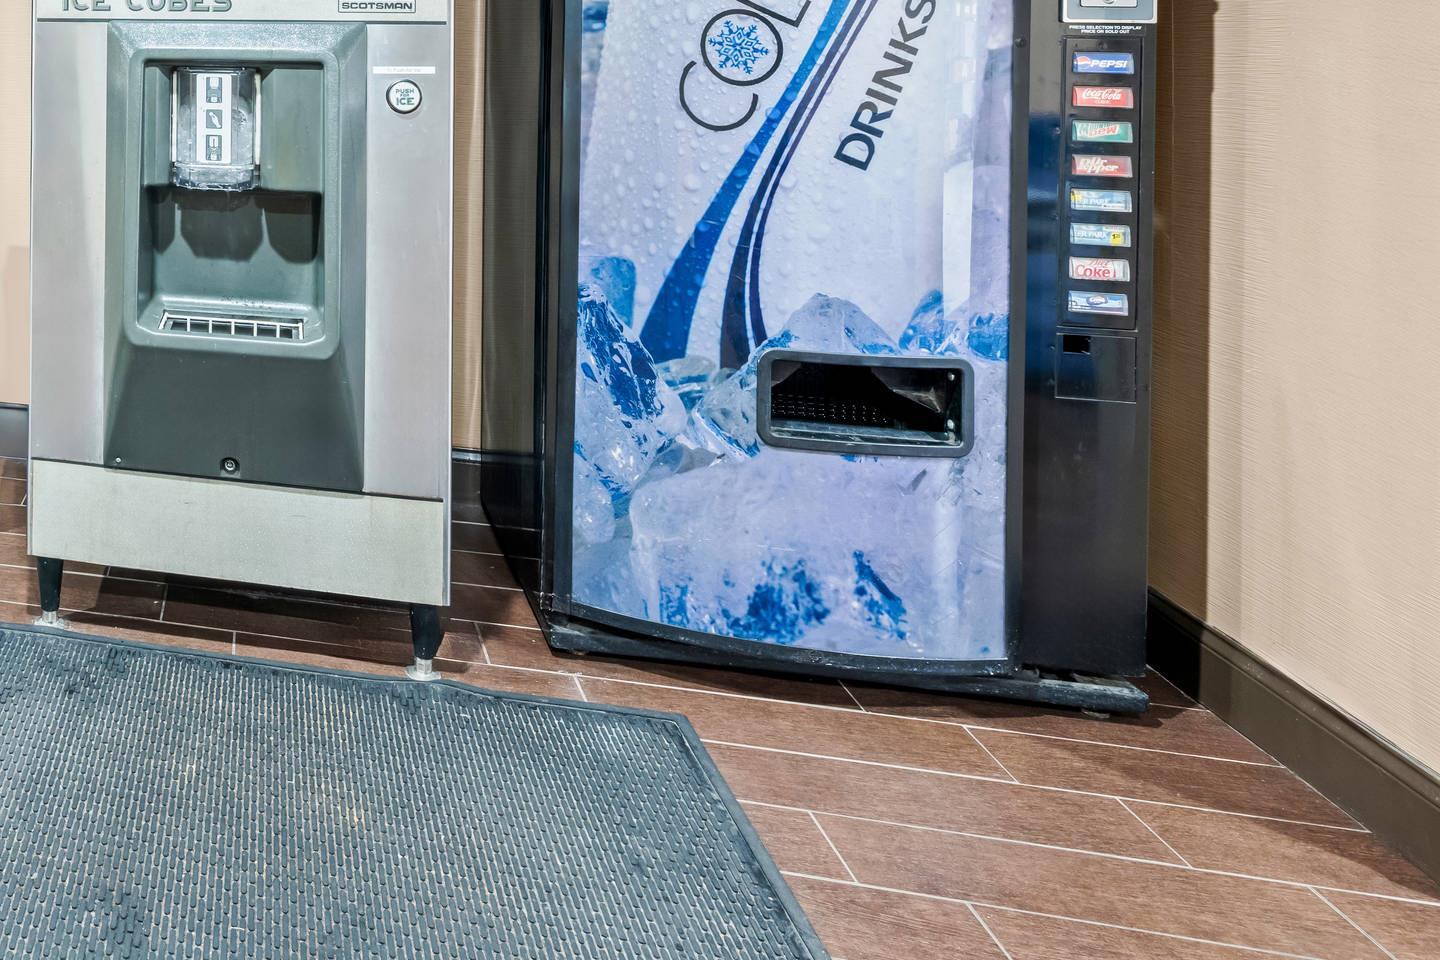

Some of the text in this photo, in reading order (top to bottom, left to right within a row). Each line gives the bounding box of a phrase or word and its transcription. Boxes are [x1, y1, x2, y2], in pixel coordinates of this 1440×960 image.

[341, 1, 414, 11] SCOTSMAN
[1090, 59, 1128, 68] PEPSI
[396, 97, 415, 106] ICE
[1075, 264, 1111, 279] Coke
